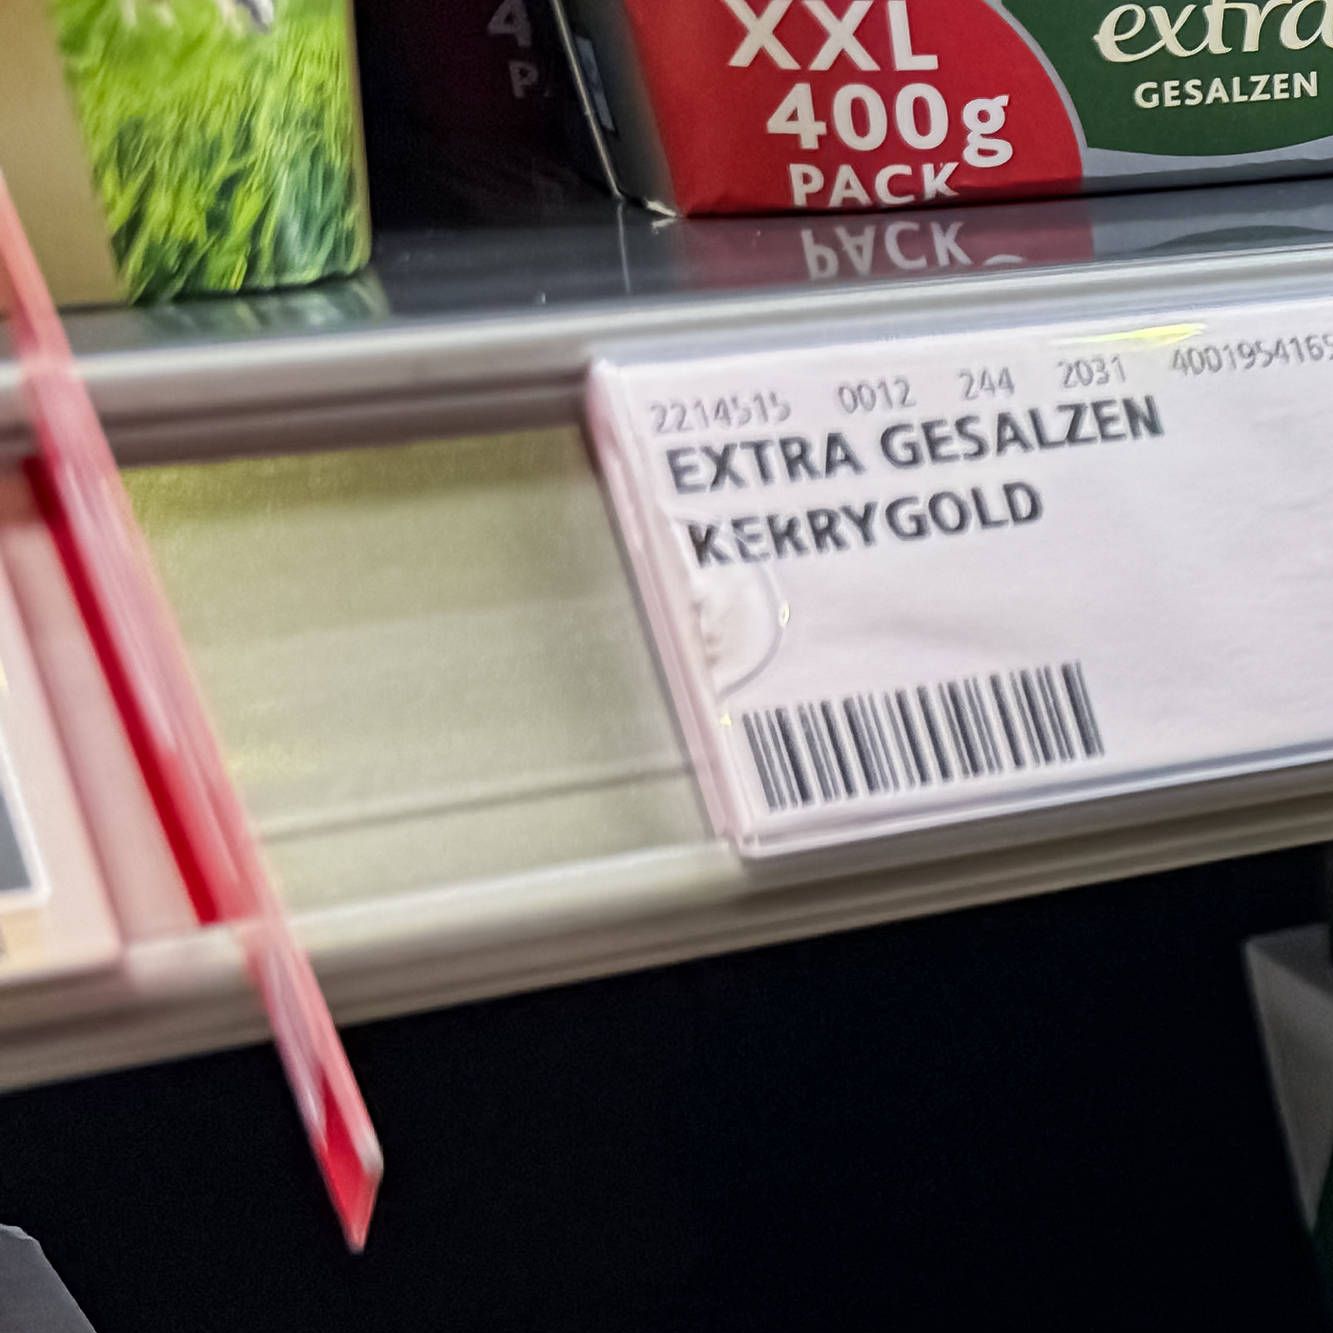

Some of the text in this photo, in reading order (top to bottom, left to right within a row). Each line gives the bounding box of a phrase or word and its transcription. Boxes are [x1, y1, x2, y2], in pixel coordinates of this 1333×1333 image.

[729, 0, 939, 71] XXL
[767, 84, 1014, 168] 400g
[1134, 71, 1319, 109] GESALZEN
[790, 161, 960, 207] PACK
[651, 398, 791, 434] 2214515
[839, 378, 912, 415] 0012
[959, 368, 1015, 400] 244
[1058, 356, 1126, 389] 2031
[666, 395, 1165, 494] EXTRA GESALZEN
